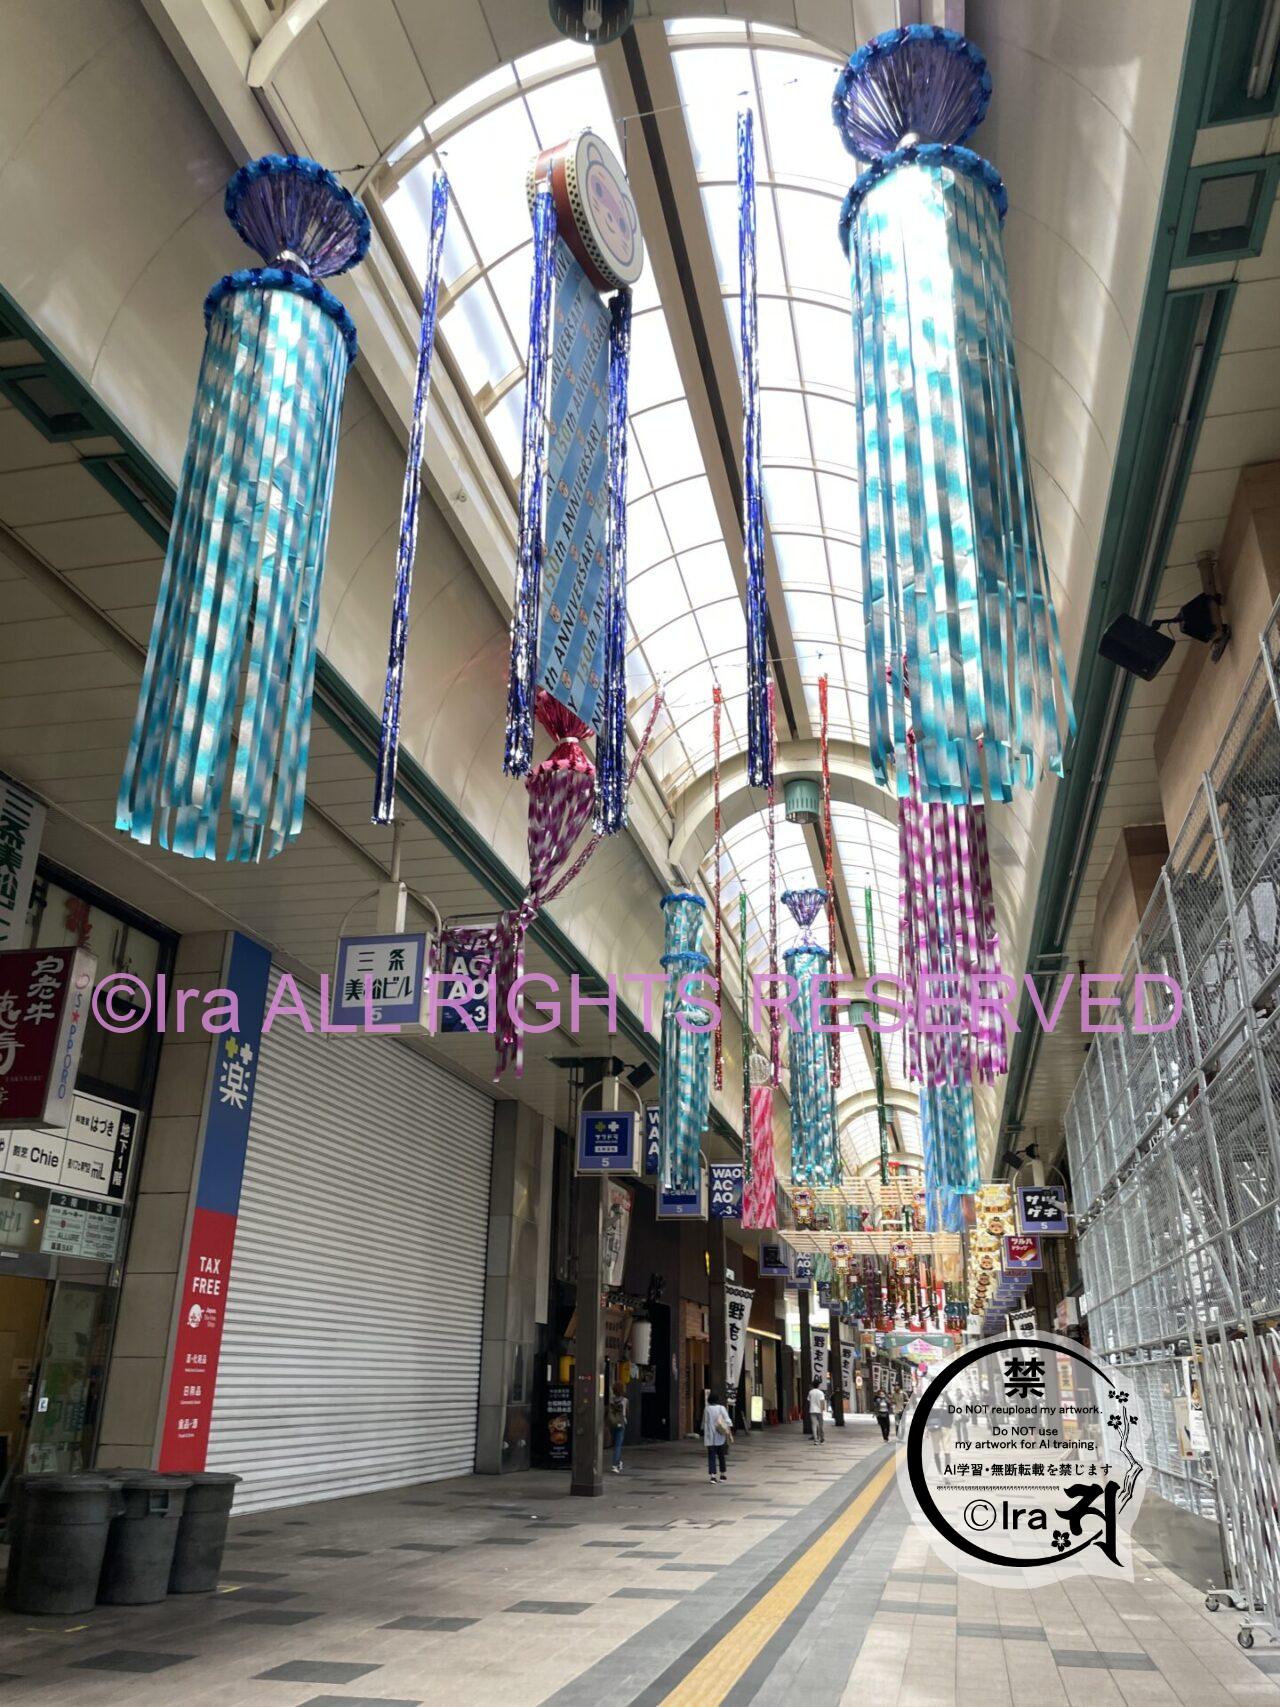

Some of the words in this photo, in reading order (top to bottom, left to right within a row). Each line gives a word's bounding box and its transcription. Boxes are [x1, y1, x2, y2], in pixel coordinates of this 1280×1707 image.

[561, 419, 601, 541] ANNIVERSARY
[554, 529, 596, 665] ANNIVERSARY
[356, 948, 406, 972] 三条
[23, 955, 65, 1026] 白老牛
[371, 1007, 383, 1022] 5
[90, 1115, 115, 1137] はづき
[30, 1147, 59, 1168] Chie
[112, 1122, 131, 1186] 地下1階
[601, 1157, 610, 1168] 5
[712, 1179, 734, 1191] AC
[712, 1192, 734, 1204] AO
[725, 1205, 733, 1215] 3
[1027, 1205, 1058, 1218] ゲキ
[1040, 1222, 1049, 1230] 5
[200, 1256, 222, 1275] TAX
[797, 1260, 811, 1268] AO
[192, 1276, 222, 1296] FREE
